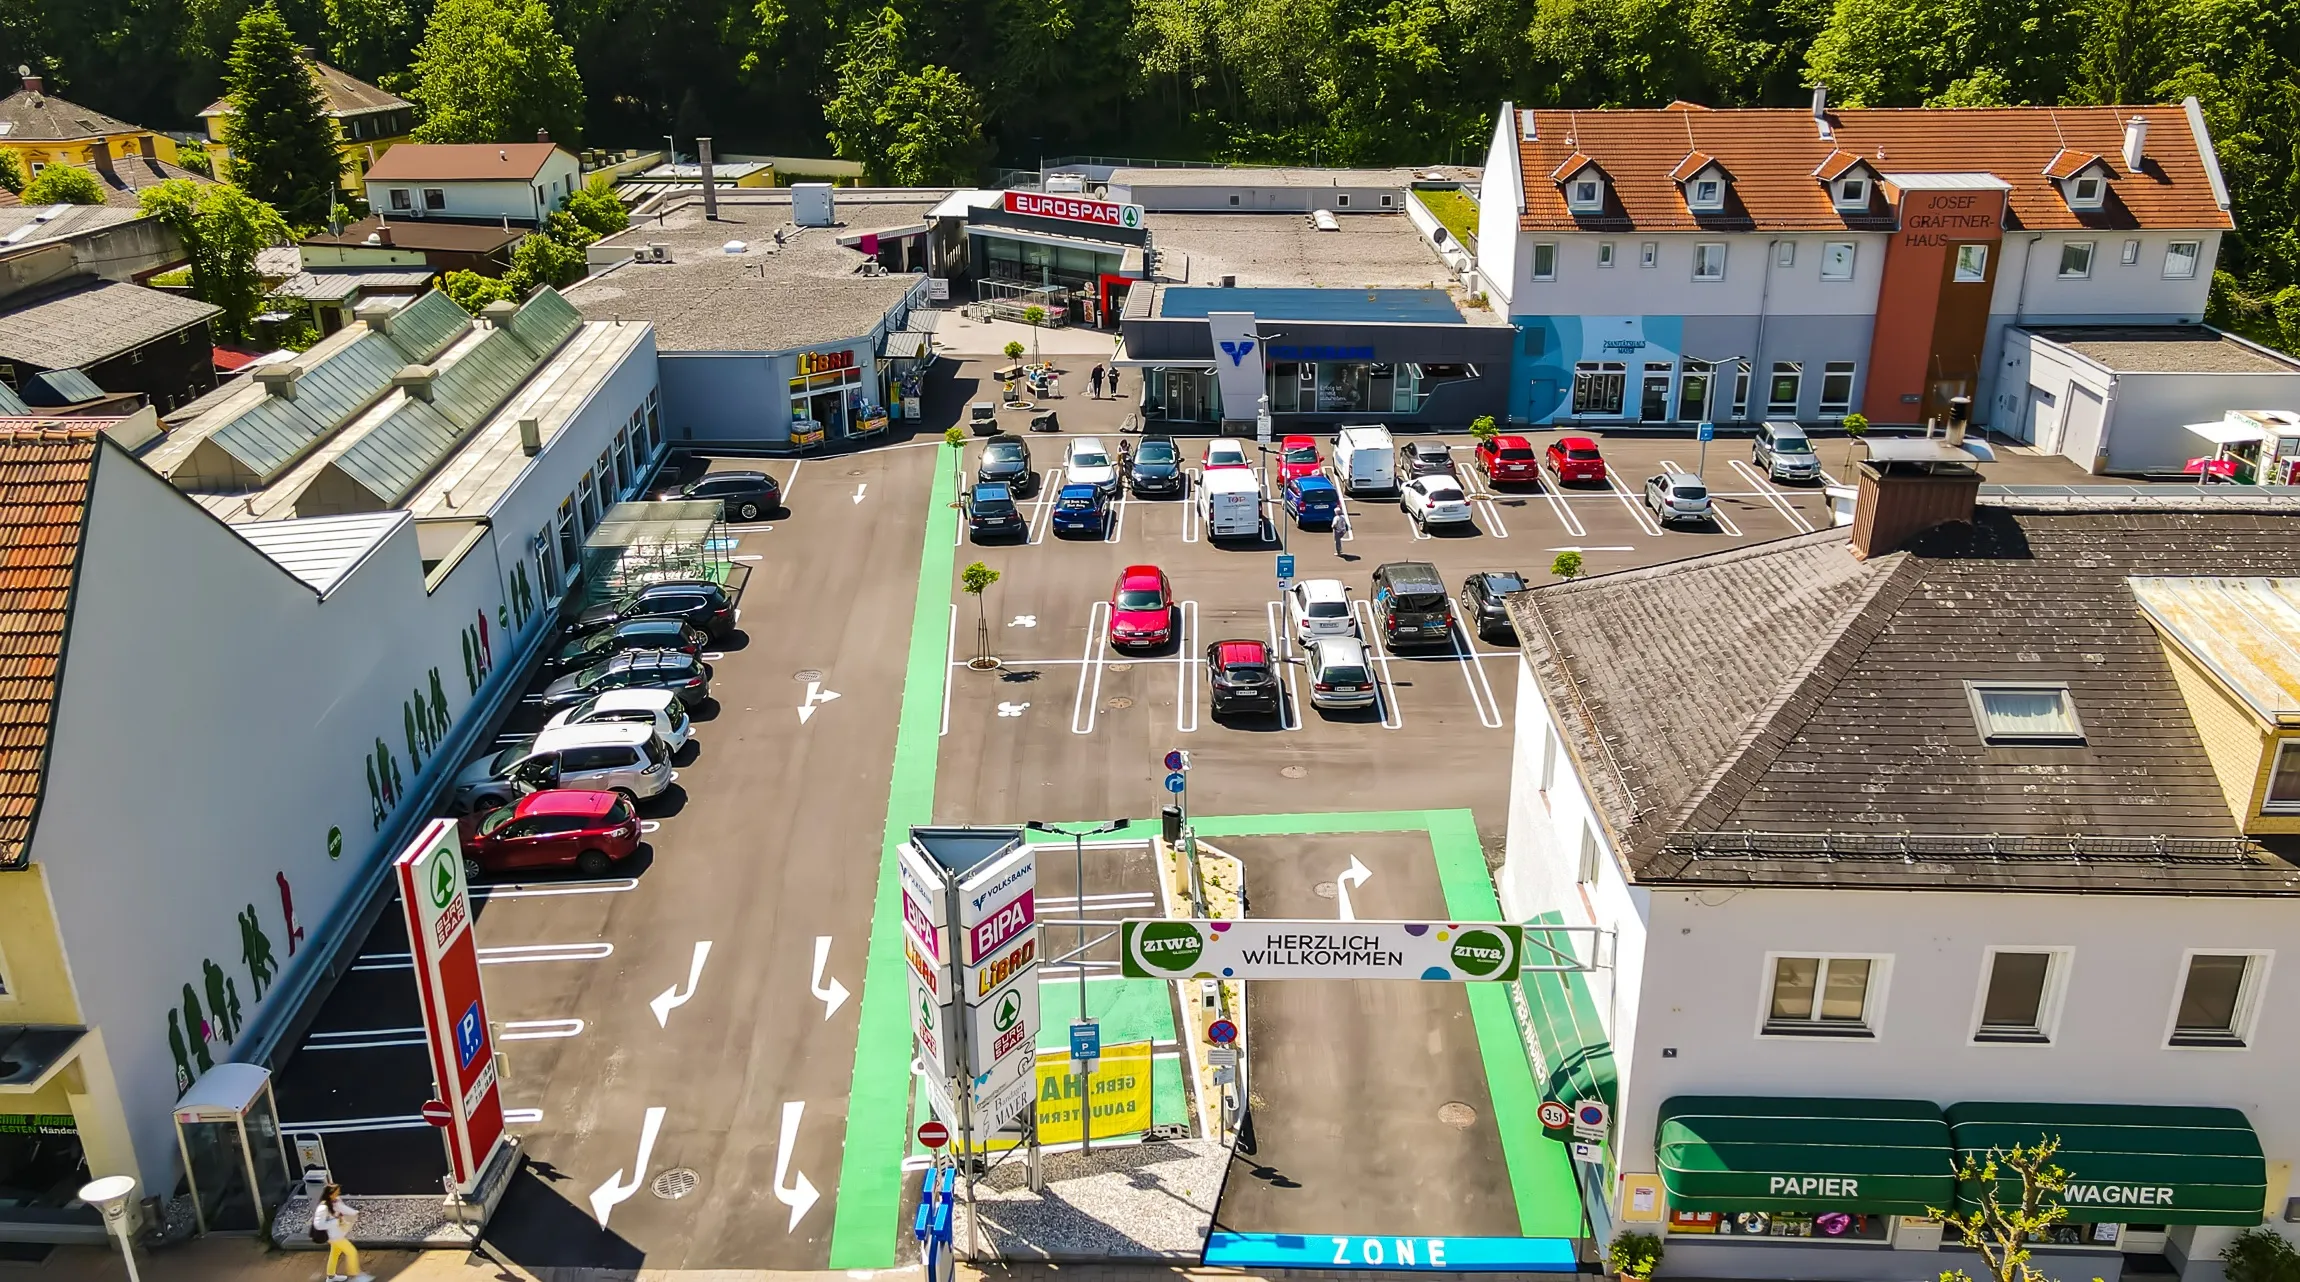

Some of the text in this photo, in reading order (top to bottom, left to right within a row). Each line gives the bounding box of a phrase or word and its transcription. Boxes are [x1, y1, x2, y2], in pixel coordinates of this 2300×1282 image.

[1016, 195, 1119, 223] EUROSPAR
[1928, 195, 1978, 210] JOSEF
[1905, 234, 1949, 247] HAUS
[988, 862, 1033, 897] VOLKSBANK
[436, 895, 462, 933] EURO
[438, 909, 465, 945] SPAR
[906, 894, 936, 954] BIPA
[978, 902, 1026, 955] BIPA
[1266, 934, 1379, 950] HERZLICH
[1143, 936, 1201, 953] ziwa
[1242, 949, 1403, 967] WILLKOMMEN
[1453, 945, 1503, 960] ziwa
[463, 1013, 474, 1046] P
[994, 1022, 1023, 1048] EURO
[995, 1031, 1025, 1059] SPAR
[996, 1091, 1028, 1127] MAYER
[1769, 1176, 1858, 1197] PAPIER
[2064, 1184, 2174, 1205] WAGNER
[1331, 1237, 1447, 1267] ZONE
